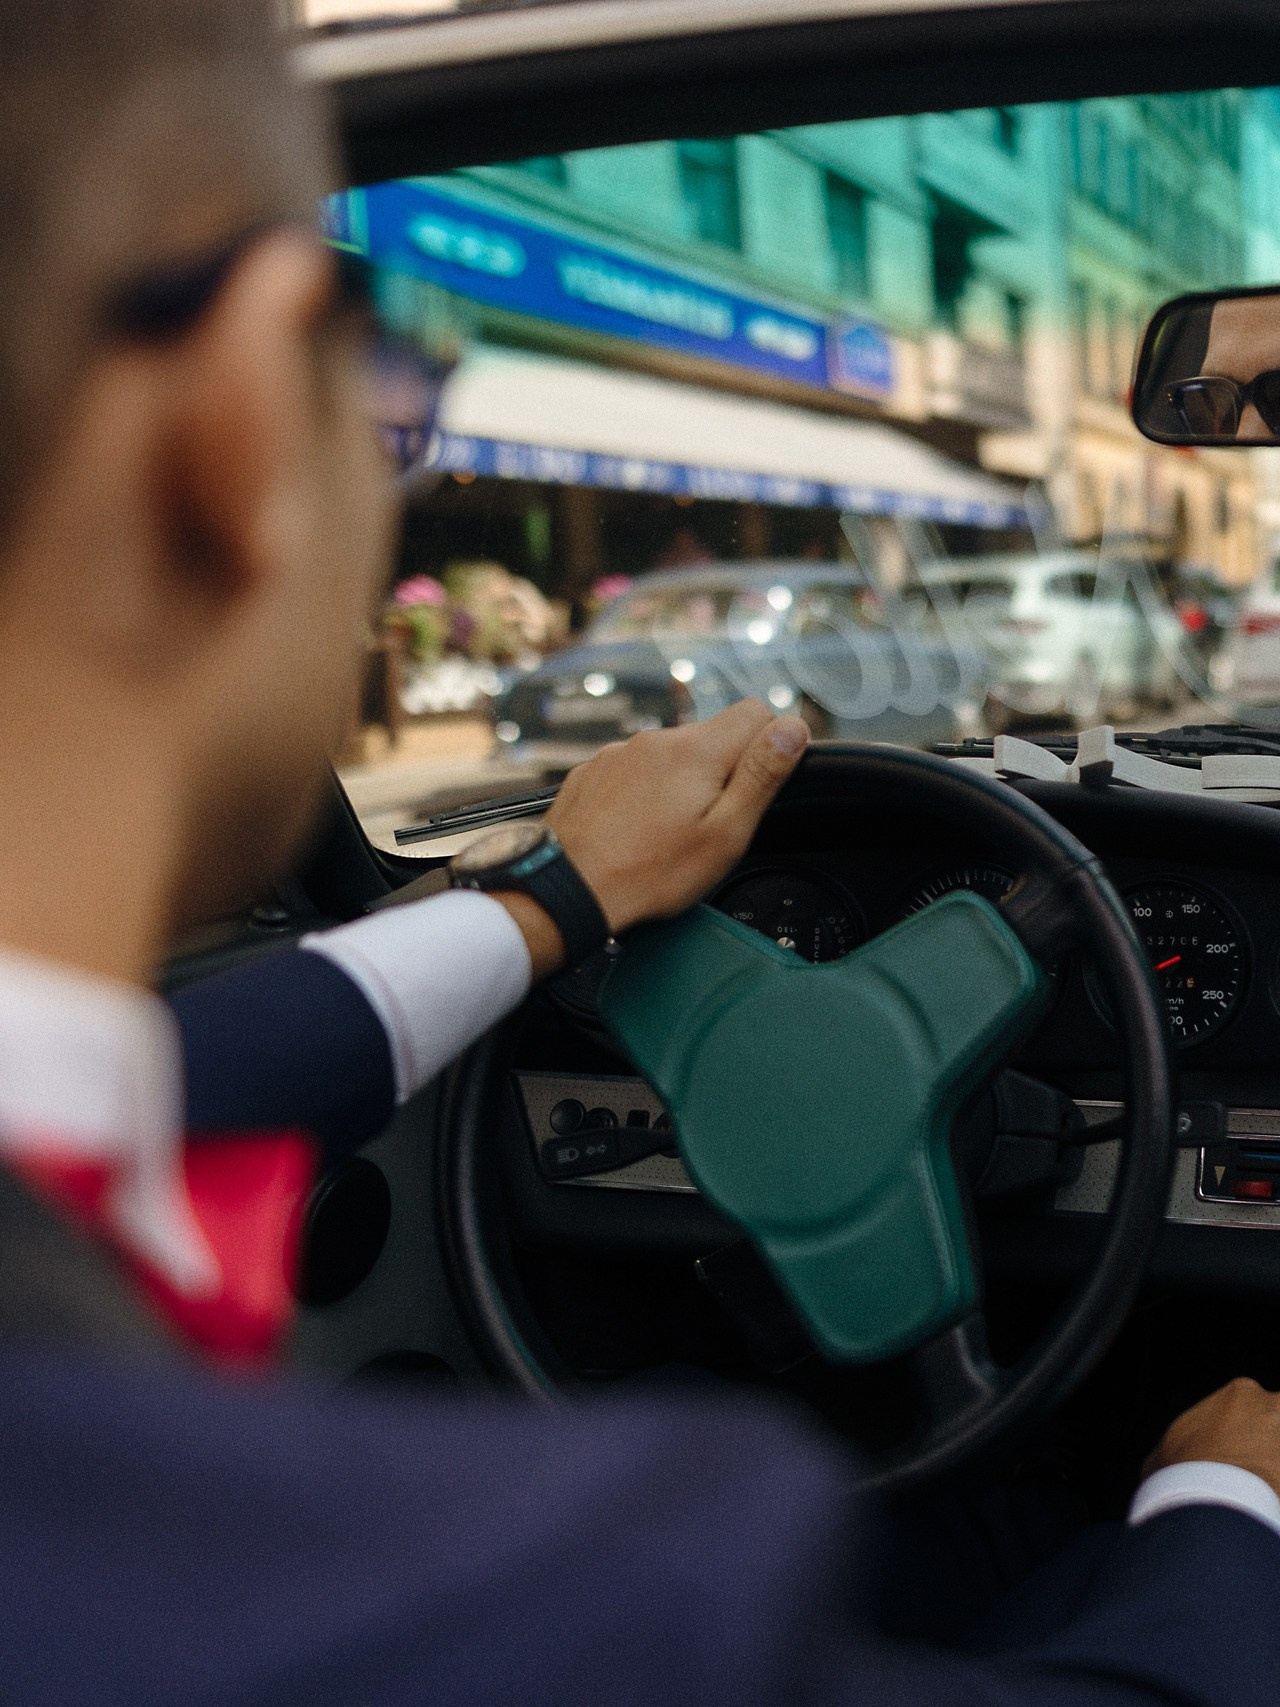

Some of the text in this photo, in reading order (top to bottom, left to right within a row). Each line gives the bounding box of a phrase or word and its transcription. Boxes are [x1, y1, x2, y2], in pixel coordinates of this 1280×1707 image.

[1133, 907, 1152, 918] 100
[1182, 904, 1201, 914] 150
[1206, 944, 1229, 954] 200
[1202, 990, 1224, 1000] 250
